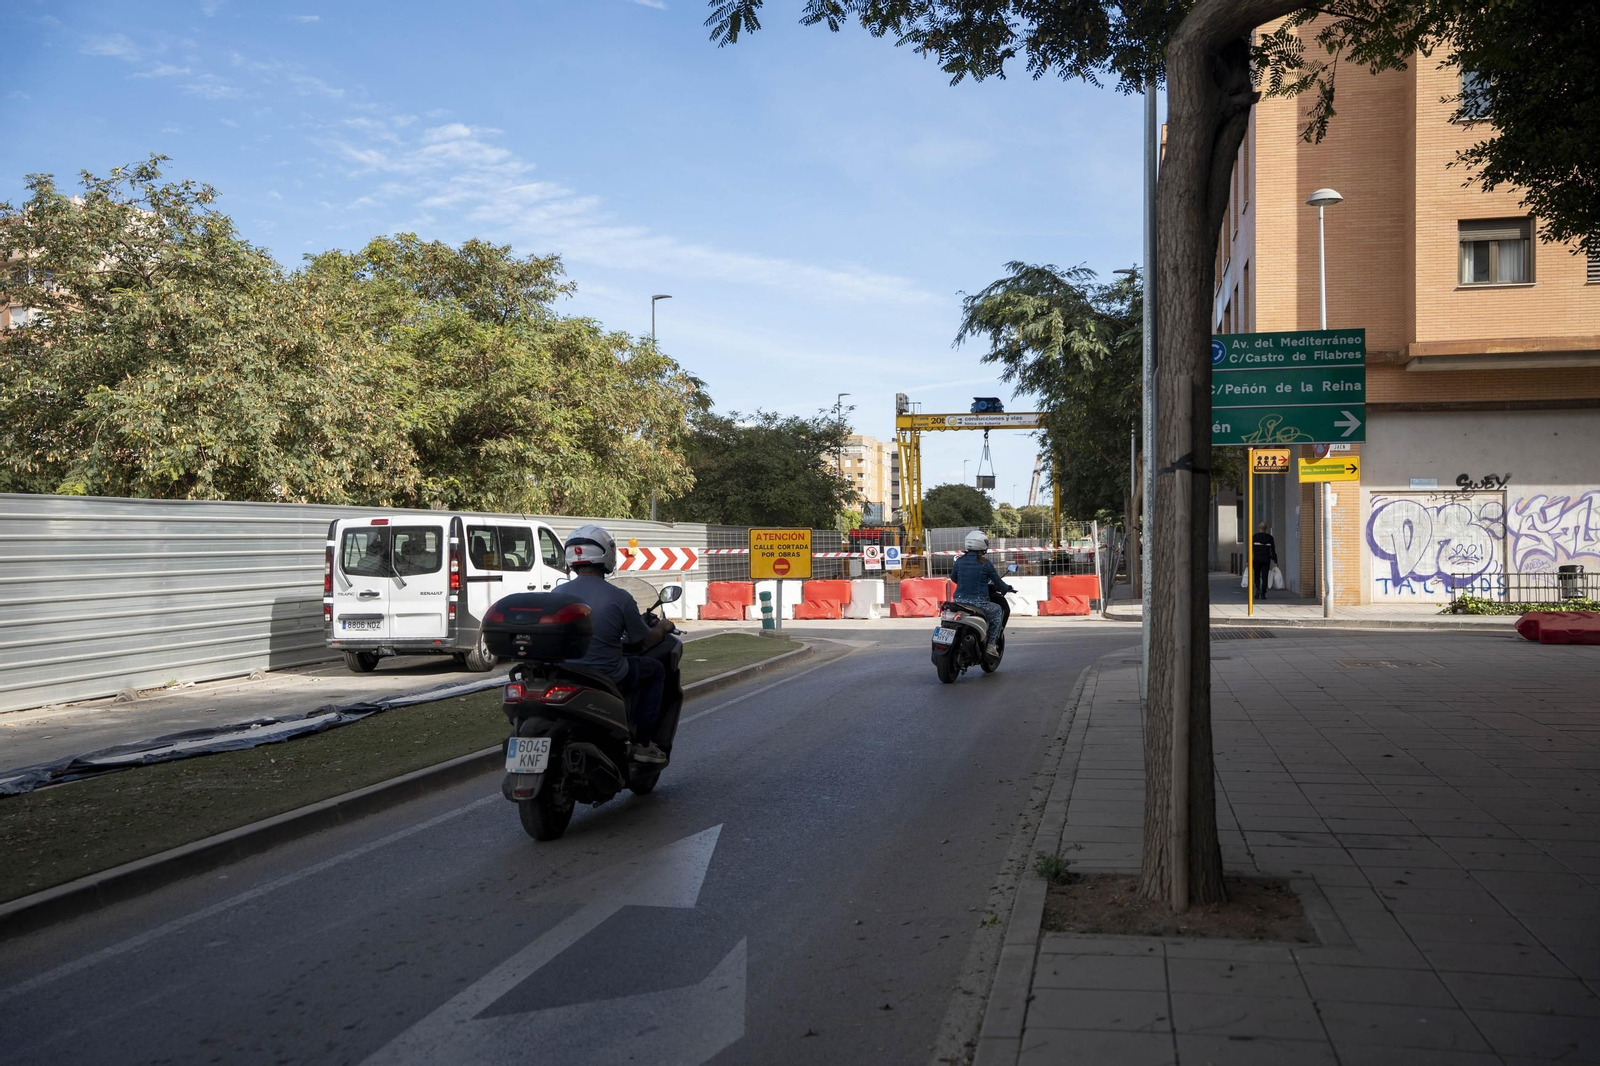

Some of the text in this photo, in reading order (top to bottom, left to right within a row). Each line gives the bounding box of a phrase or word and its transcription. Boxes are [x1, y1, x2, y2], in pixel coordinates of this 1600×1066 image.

[1232, 335, 1362, 349] Av. del Mediterráneo
[1229, 350, 1362, 364] C/Castro de Filabres
[1276, 382, 1292, 393] de
[1301, 382, 1313, 392] la
[1322, 380, 1362, 391] Reina
[1212, 421, 1231, 433] én
[756, 532, 805, 541] ATENCIÓN
[518, 740, 548, 753] 6045
[520, 754, 542, 767] KNF
